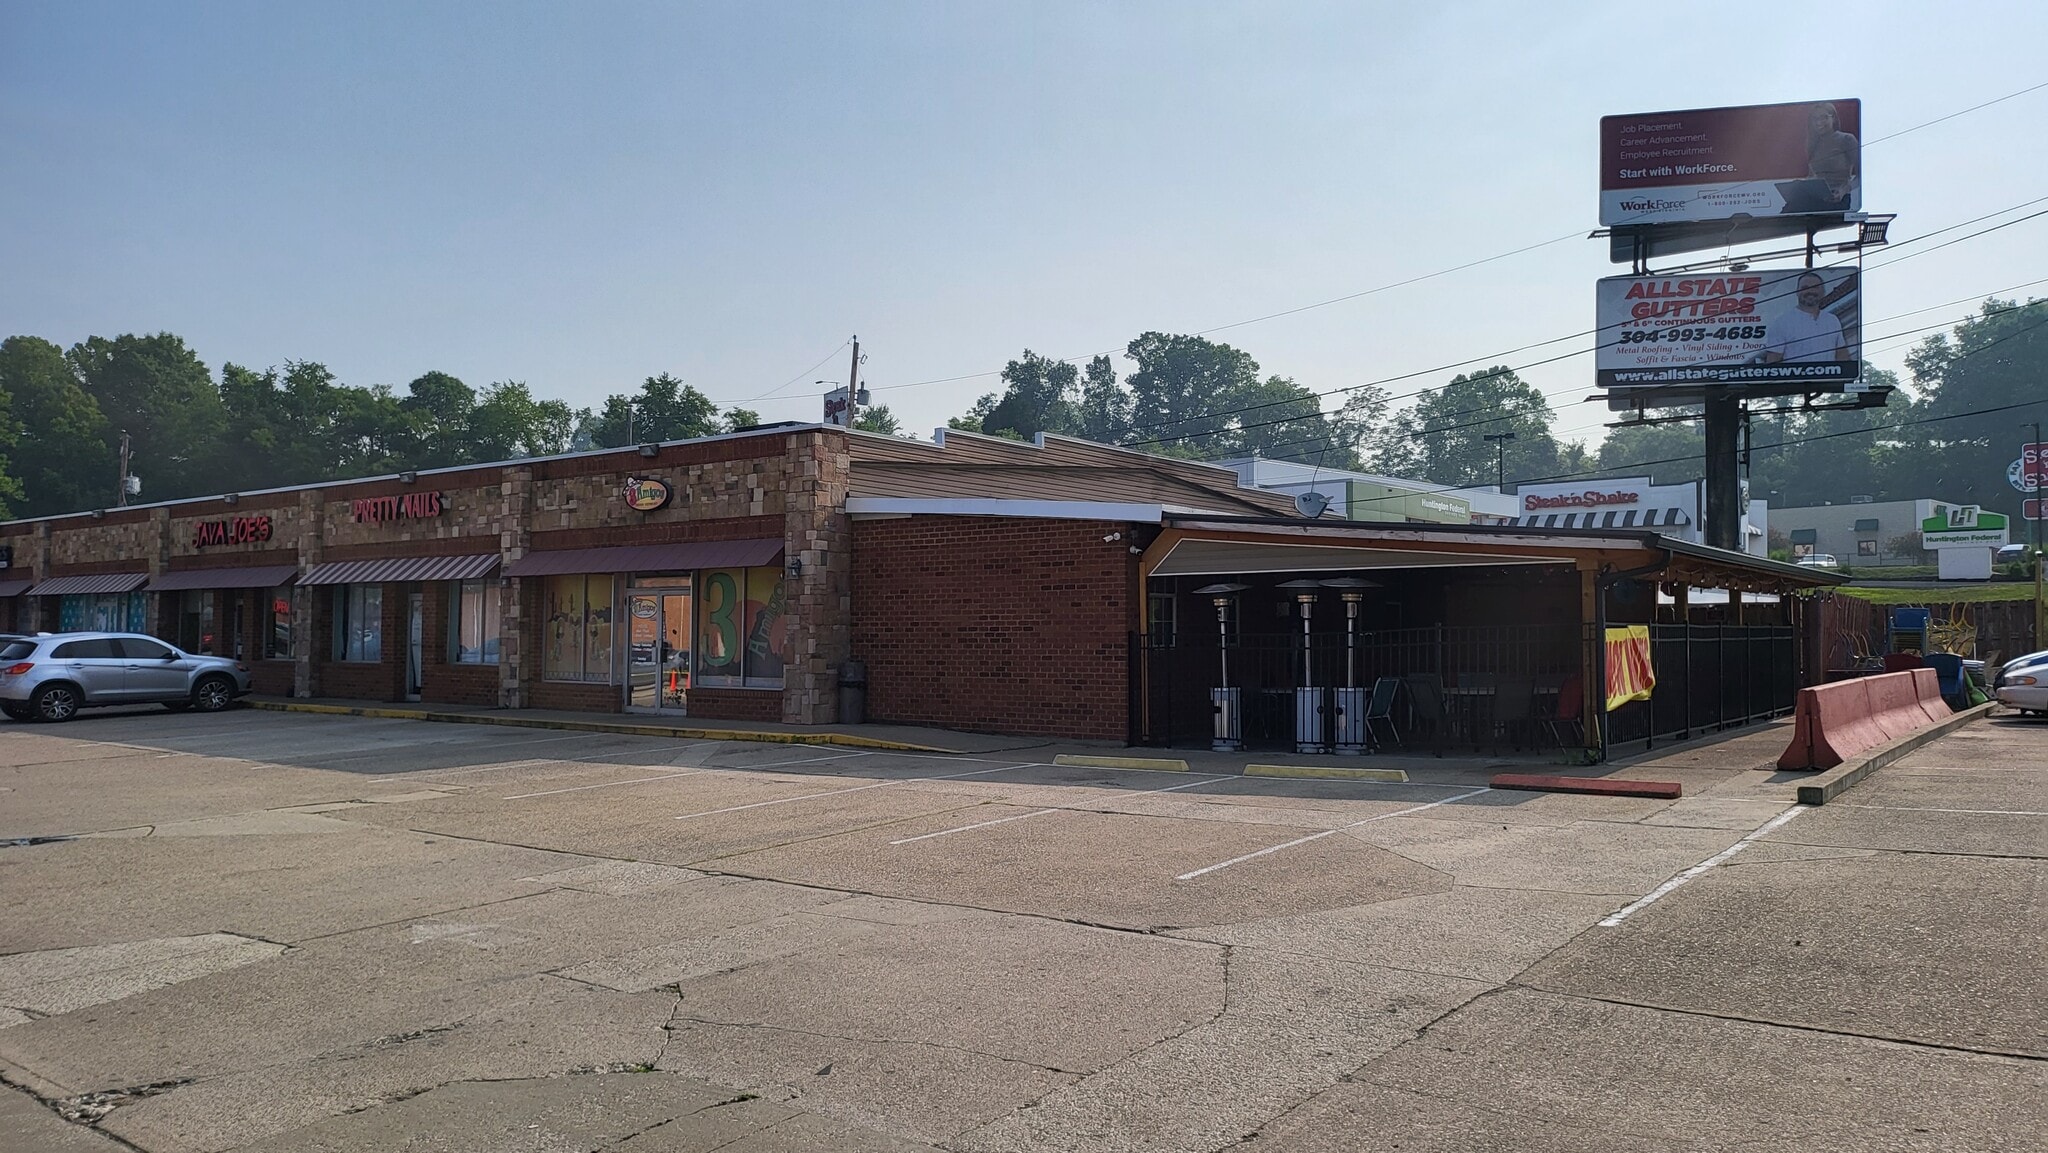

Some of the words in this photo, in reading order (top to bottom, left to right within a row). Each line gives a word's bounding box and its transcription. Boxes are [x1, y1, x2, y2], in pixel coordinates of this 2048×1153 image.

[1620, 125, 1636, 134] Job
[1620, 137, 1647, 147] Career
[1620, 149, 1660, 160] Employee
[1662, 146, 1713, 157] Recruitment
[1620, 169, 1647, 179] Start
[1649, 166, 1672, 177] with
[1675, 163, 1737, 175] WorkForce.
[1619, 199, 1686, 212] WorkForce
[1624, 277, 1762, 300] ALLSTATE
[1631, 297, 1756, 319] GUTTERS
[1654, 317, 1716, 327] CONTINUOUS
[1718, 315, 1762, 324] GUTTERS
[1620, 325, 1767, 345] 304-993-4685
[1615, 346, 1639, 355] Metal
[1641, 345, 1673, 355] Roofing
[1682, 343, 1705, 354] Vinyl
[1707, 342, 1733, 352] Siding
[1742, 342, 1767, 350] Doors
[1635, 355, 1658, 365] Soffit
[1670, 354, 1697, 363] Fascia
[1706, 353, 1745, 362] Windows
[1614, 365, 1842, 382] www.allstategutterswv.com
[354, 495, 400, 523] PRETTY
[403, 490, 442, 519] NAILS
[1583, 490, 1639, 508] Shake
[192, 519, 227, 549] JAVA
[228, 514, 273, 545] JOE'S
[1925, 535, 1970, 543] Huntington
[1971, 533, 2002, 541] Federal
[273, 599, 290, 614] OPEN
[702, 571, 738, 667] 3
[748, 581, 785, 661] Amigo
